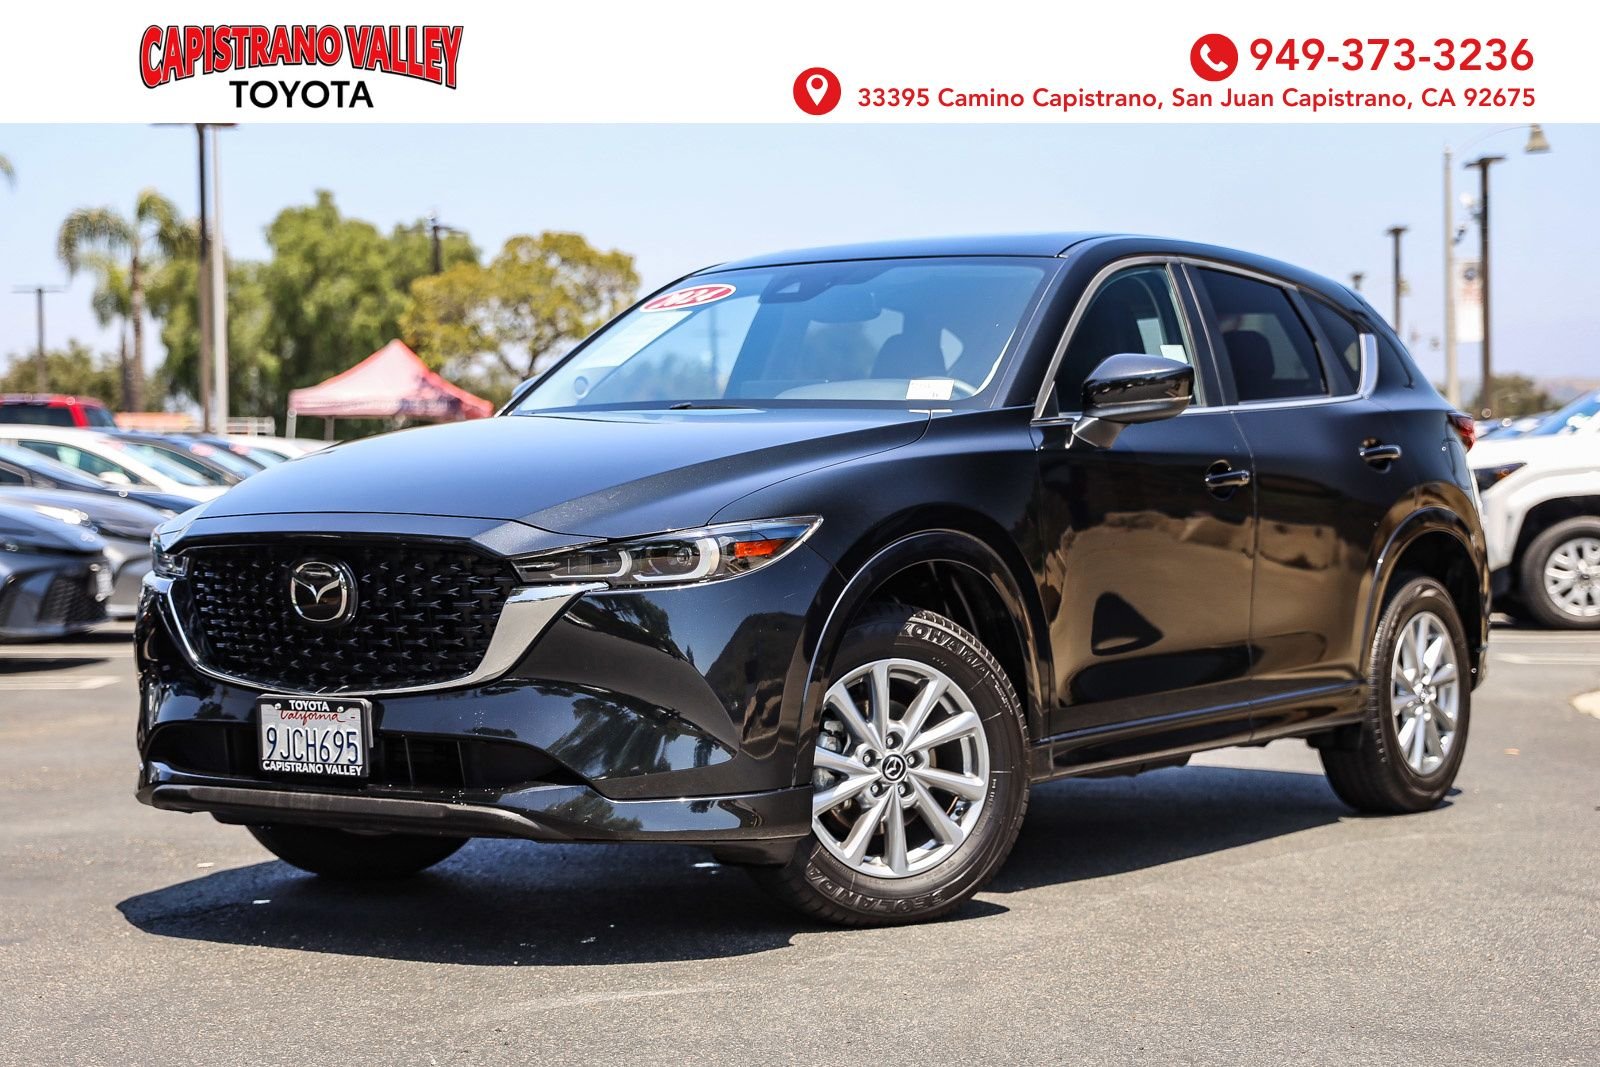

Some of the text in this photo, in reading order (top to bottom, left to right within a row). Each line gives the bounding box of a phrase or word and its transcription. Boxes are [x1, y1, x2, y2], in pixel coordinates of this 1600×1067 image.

[289, 700, 330, 711] TOYOTA
[280, 710, 346, 726] California
[266, 726, 358, 765] 9JCH695
[262, 761, 363, 776] CAPISTRANO VALLEY
